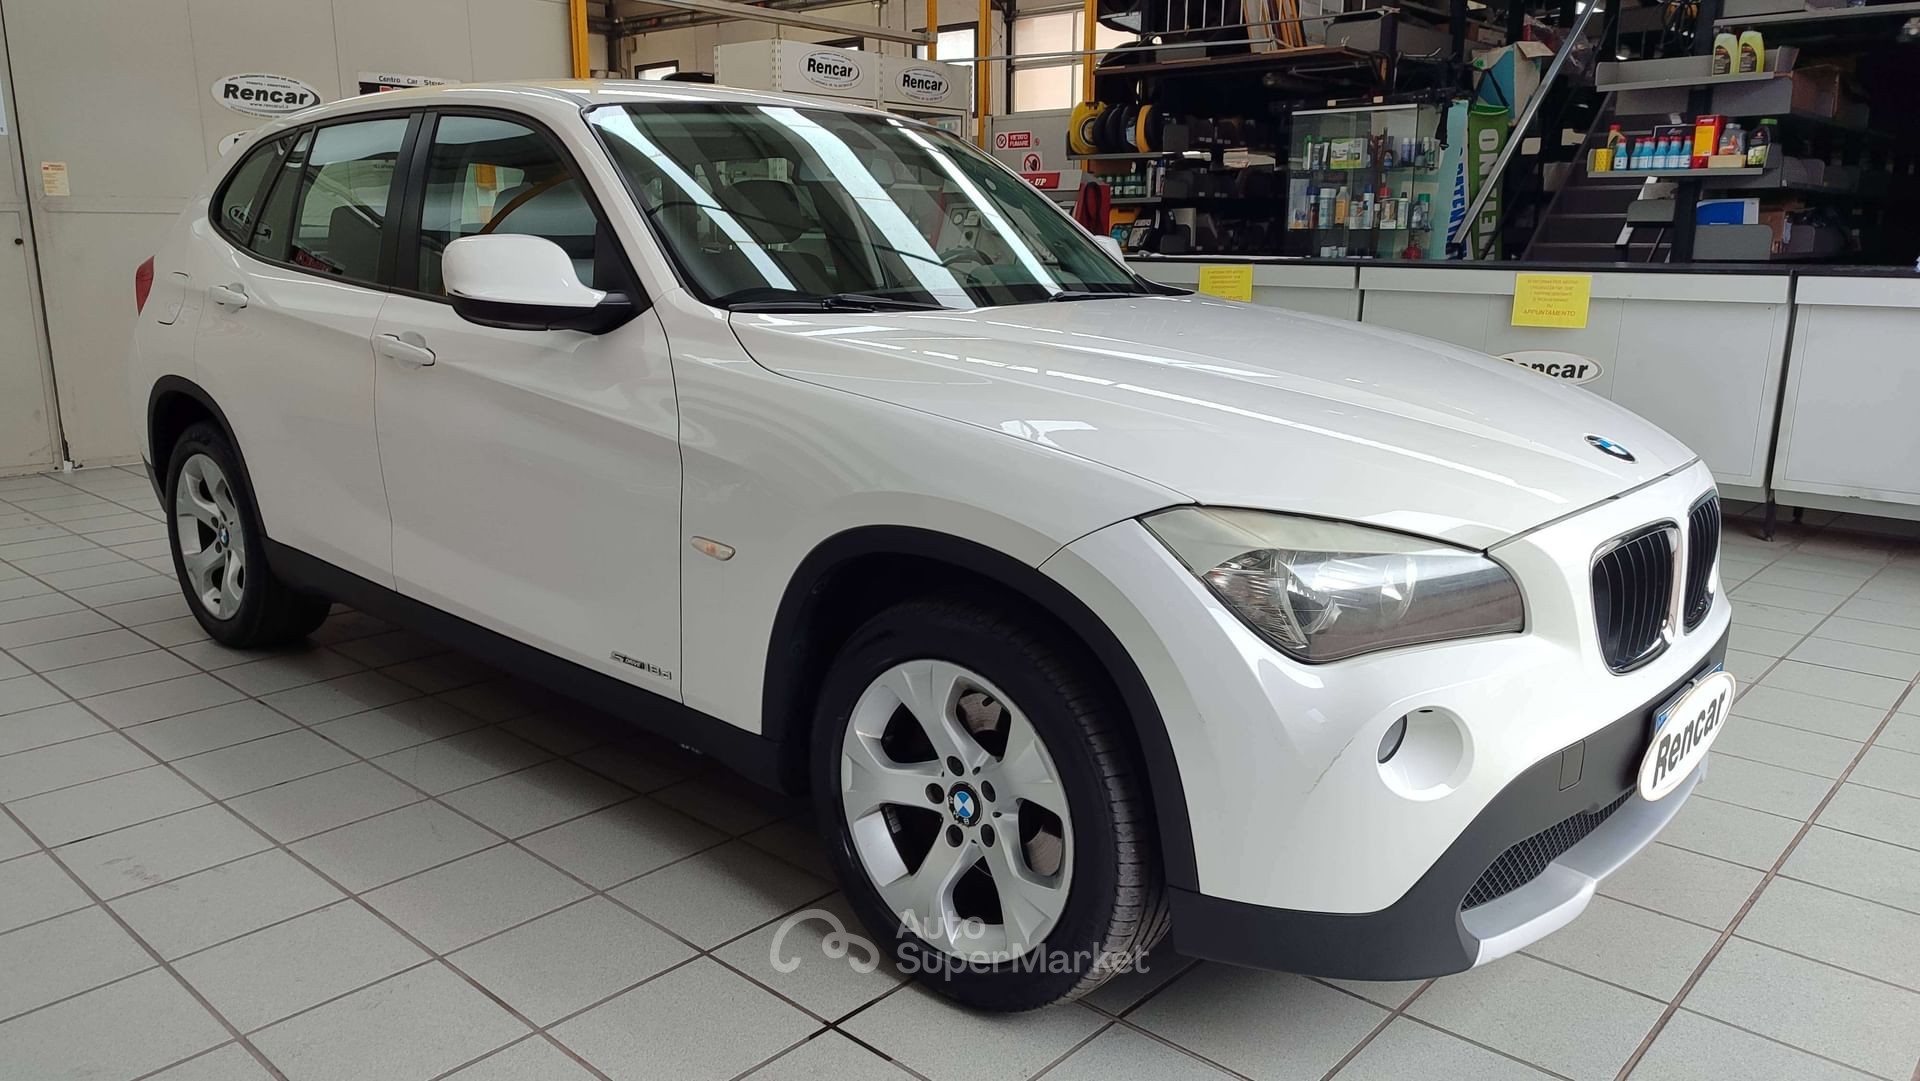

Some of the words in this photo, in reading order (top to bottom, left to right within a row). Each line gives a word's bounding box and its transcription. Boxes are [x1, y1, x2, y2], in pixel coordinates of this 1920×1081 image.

[807, 57, 853, 78] Rencar
[378, 75, 401, 84] Centro
[902, 73, 943, 92] Rencar
[223, 83, 309, 105] Rencar
[1652, 687, 1728, 791] Rencar
